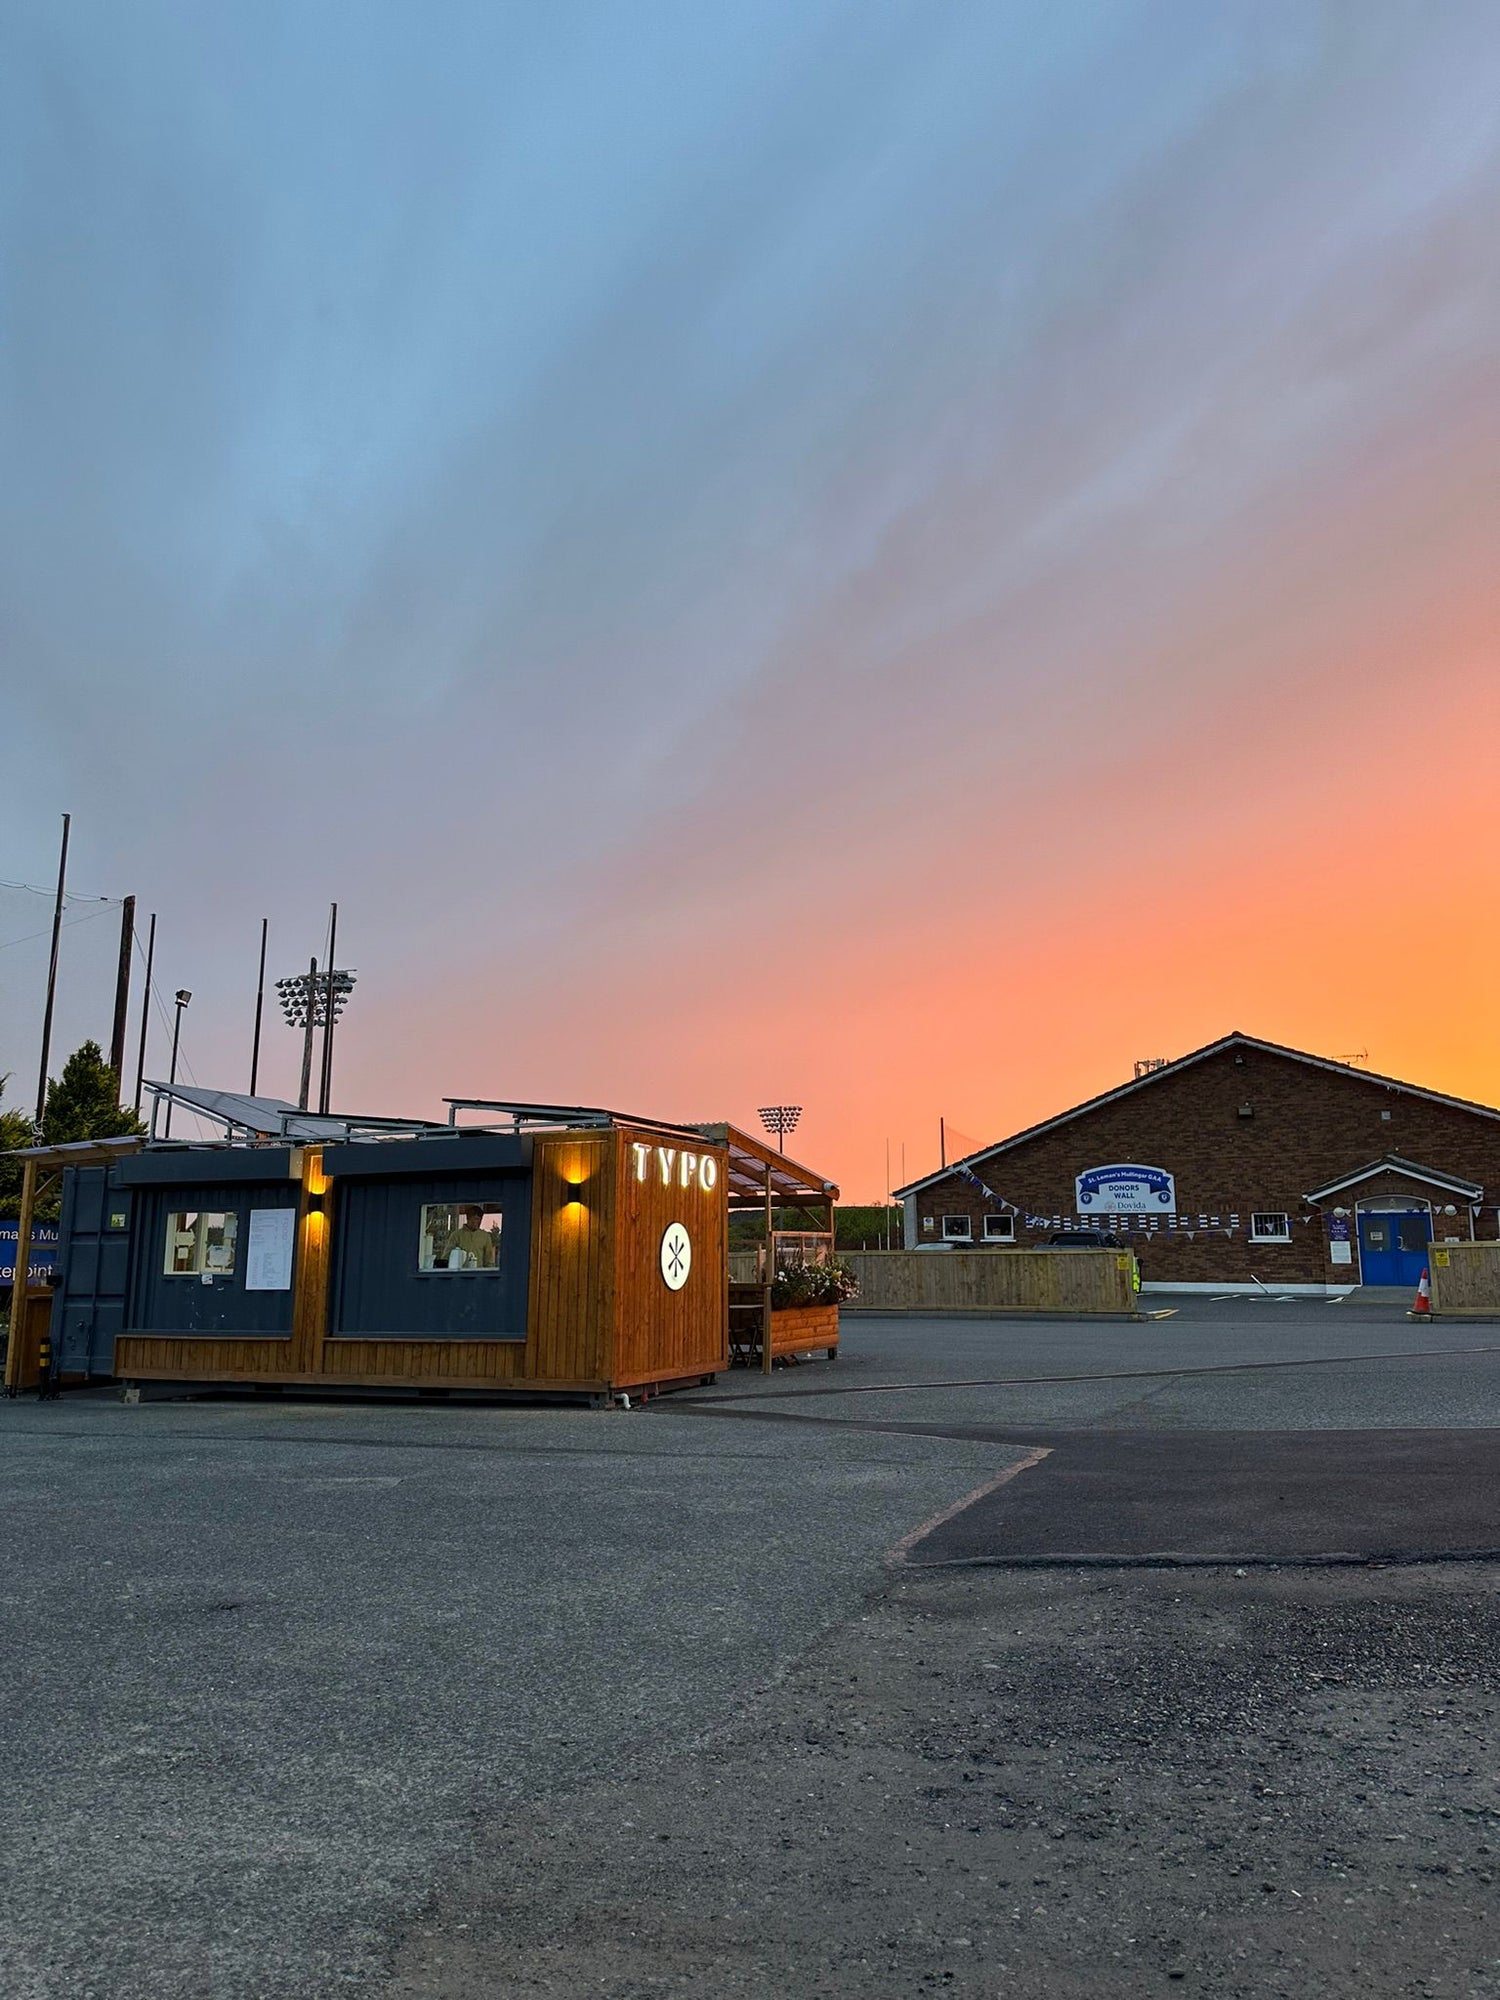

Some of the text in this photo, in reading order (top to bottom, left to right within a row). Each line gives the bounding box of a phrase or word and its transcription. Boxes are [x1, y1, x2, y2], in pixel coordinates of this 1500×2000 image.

[634, 1142, 717, 1190] TYPO
[1148, 1174, 1162, 1182] GAA
[1117, 1201, 1146, 1209] Dovida
